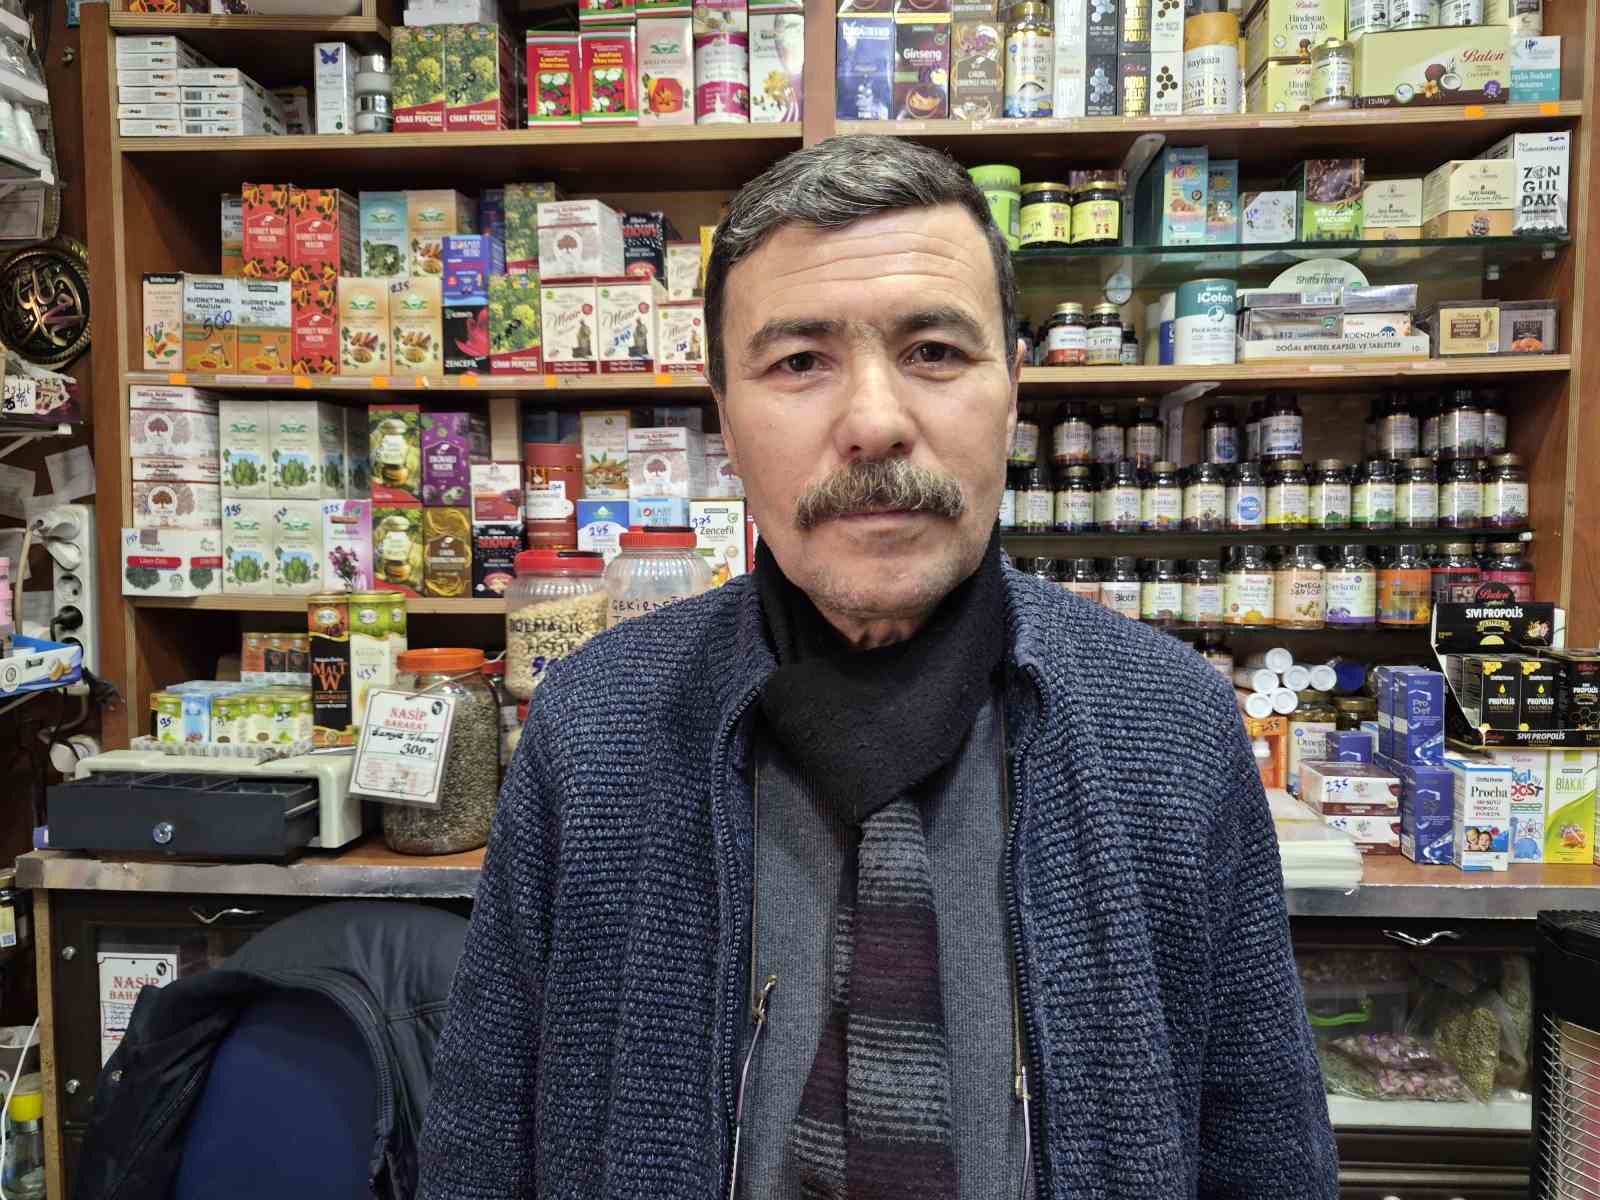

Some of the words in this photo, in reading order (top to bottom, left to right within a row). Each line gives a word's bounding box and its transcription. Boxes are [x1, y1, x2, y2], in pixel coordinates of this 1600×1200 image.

[904, 48, 942, 61] Ginseng
[1197, 291, 1233, 304] iColon
[700, 526, 734, 536] Zencefil
[1484, 606, 1524, 618] PROPOLİS
[312, 660, 348, 676] MALT
[319, 674, 342, 690] W
[1488, 697, 1516, 705] PROPOLİS
[1527, 697, 1555, 705] PROPOLİS
[389, 706, 428, 719] NASİP
[1471, 785, 1508, 798] Procha
[112, 973, 159, 988] NASİP
